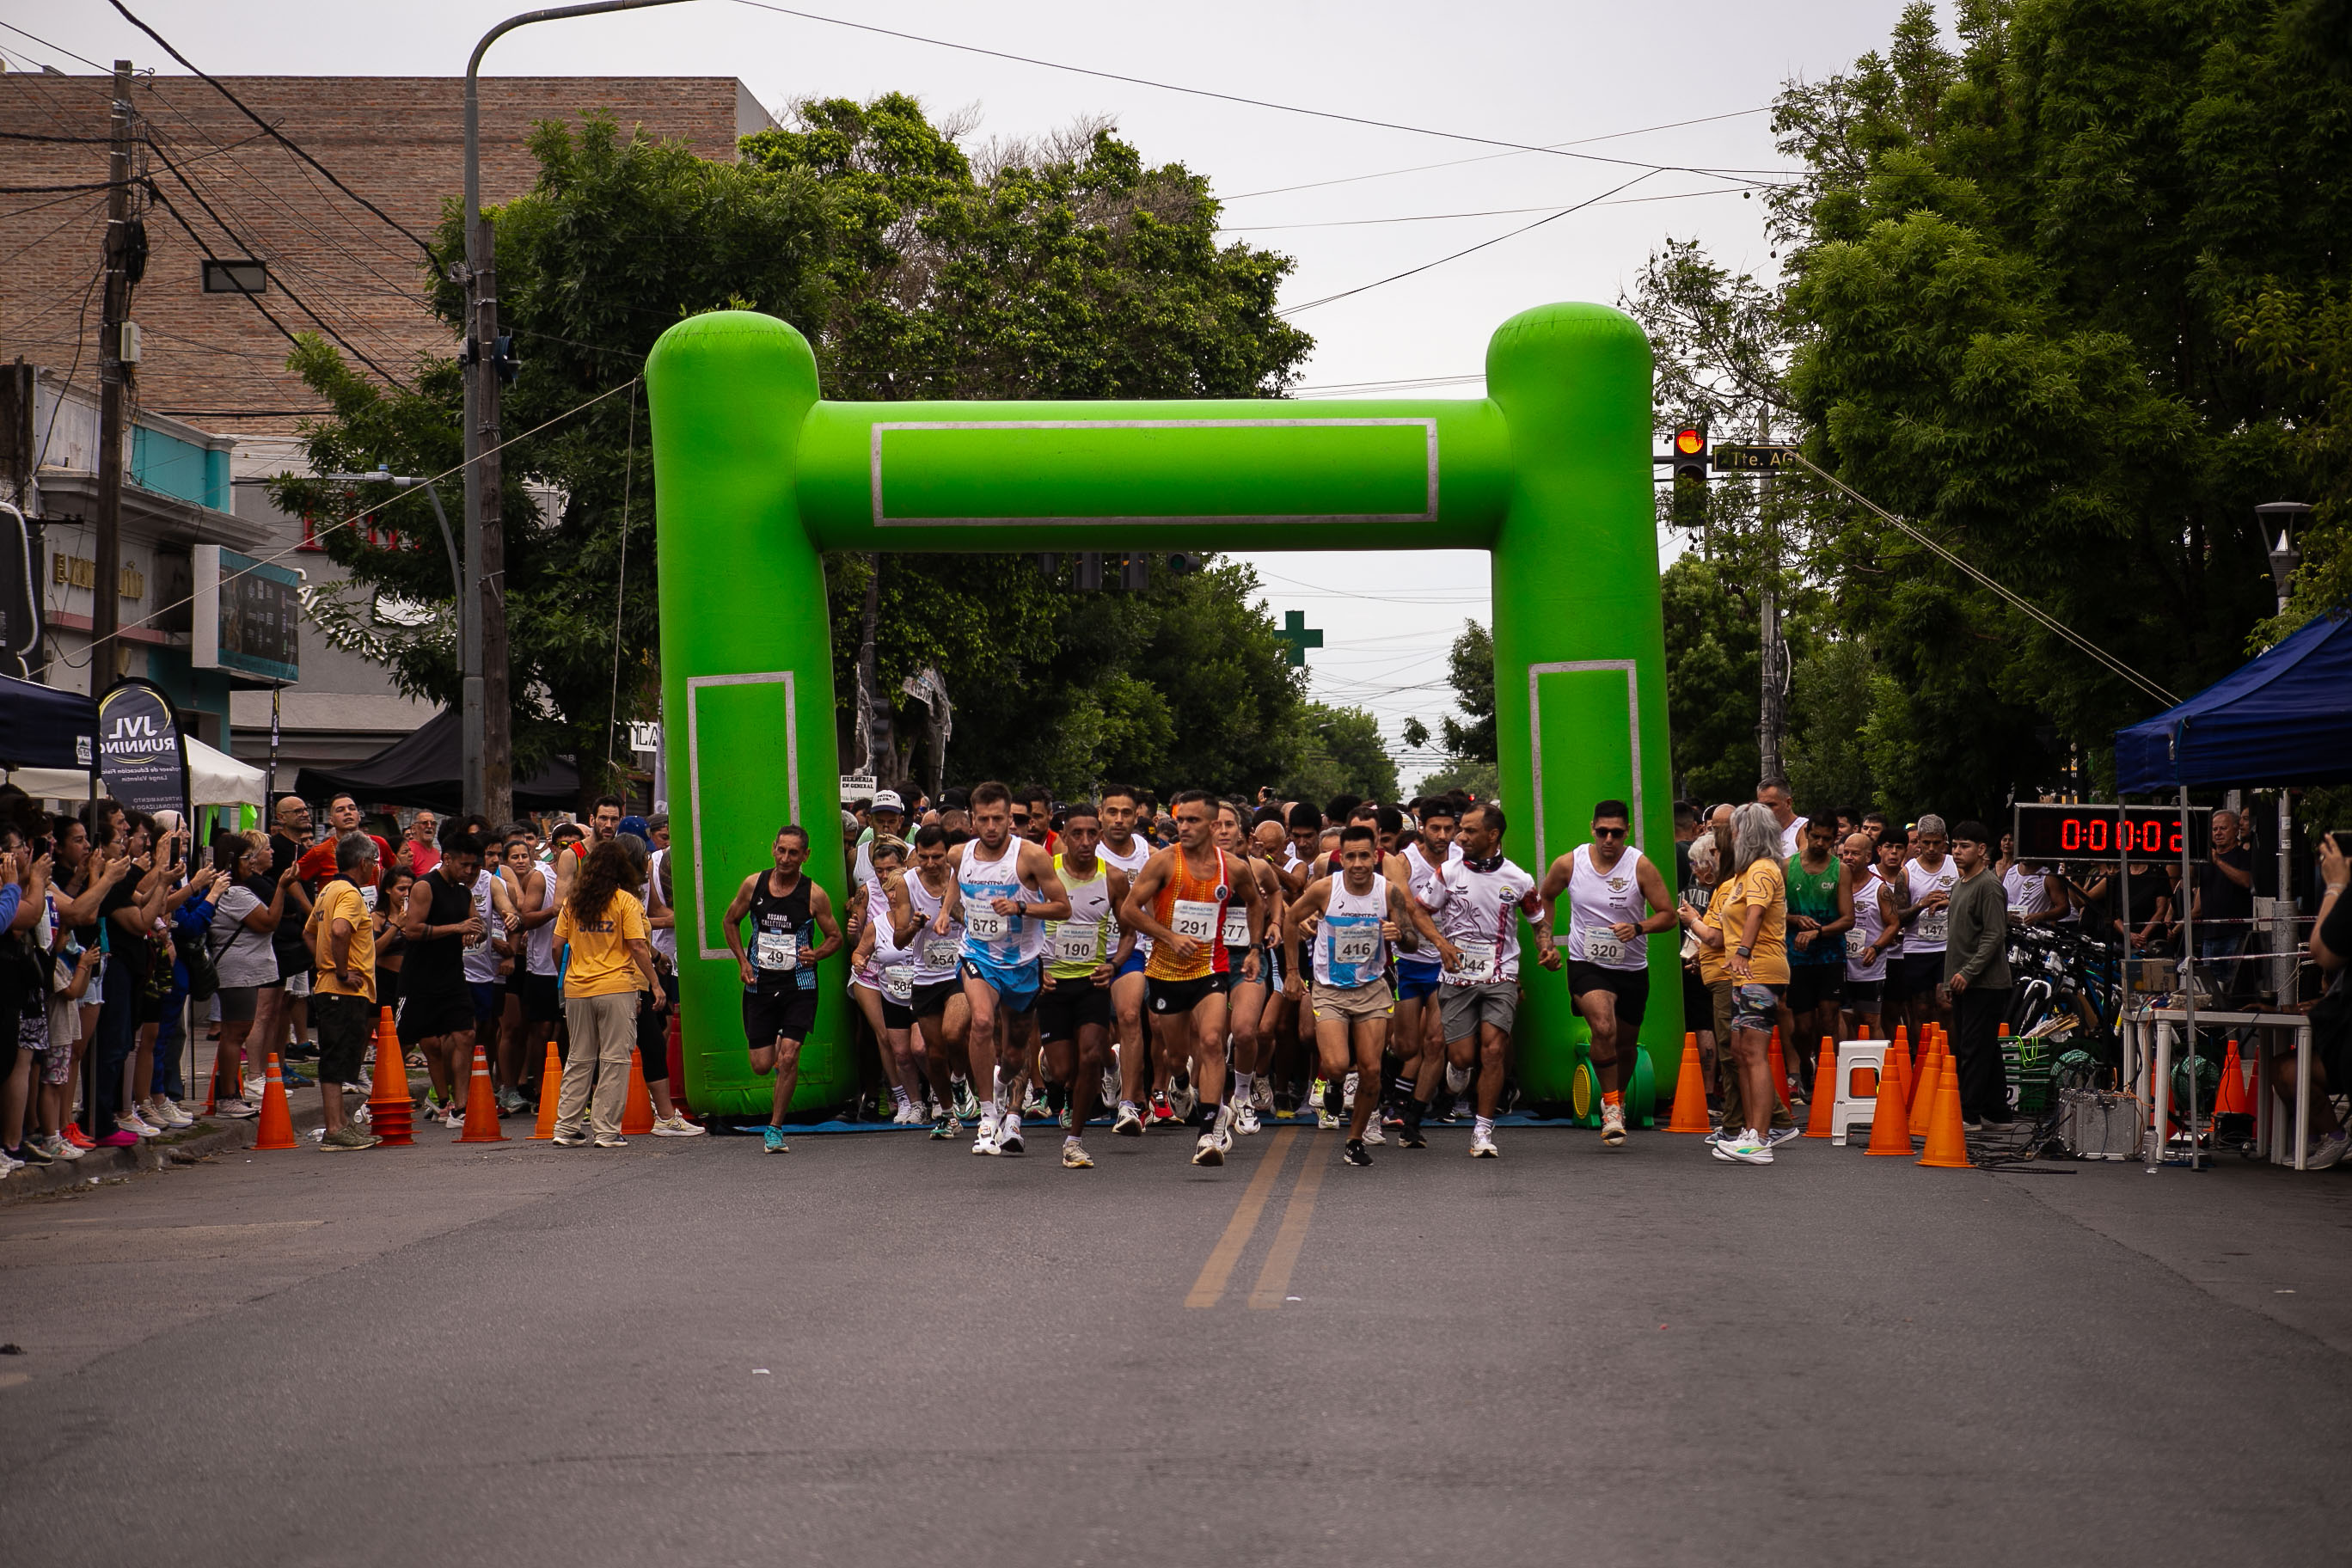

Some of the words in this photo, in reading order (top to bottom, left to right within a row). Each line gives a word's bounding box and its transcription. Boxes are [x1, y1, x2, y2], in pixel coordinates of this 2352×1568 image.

[1730, 451, 1764, 466] Tte.
[1821, 881, 1835, 890] CM
[767, 913, 787, 922] ROSARIO
[972, 918, 999, 934] 678
[1179, 920, 1209, 935] 291
[1924, 924, 1944, 935] 147
[1063, 942, 1090, 957] 190
[1342, 942, 1371, 956] 416
[1590, 943, 1617, 958] 320
[767, 950, 784, 963] 49
[930, 954, 956, 966] 254
